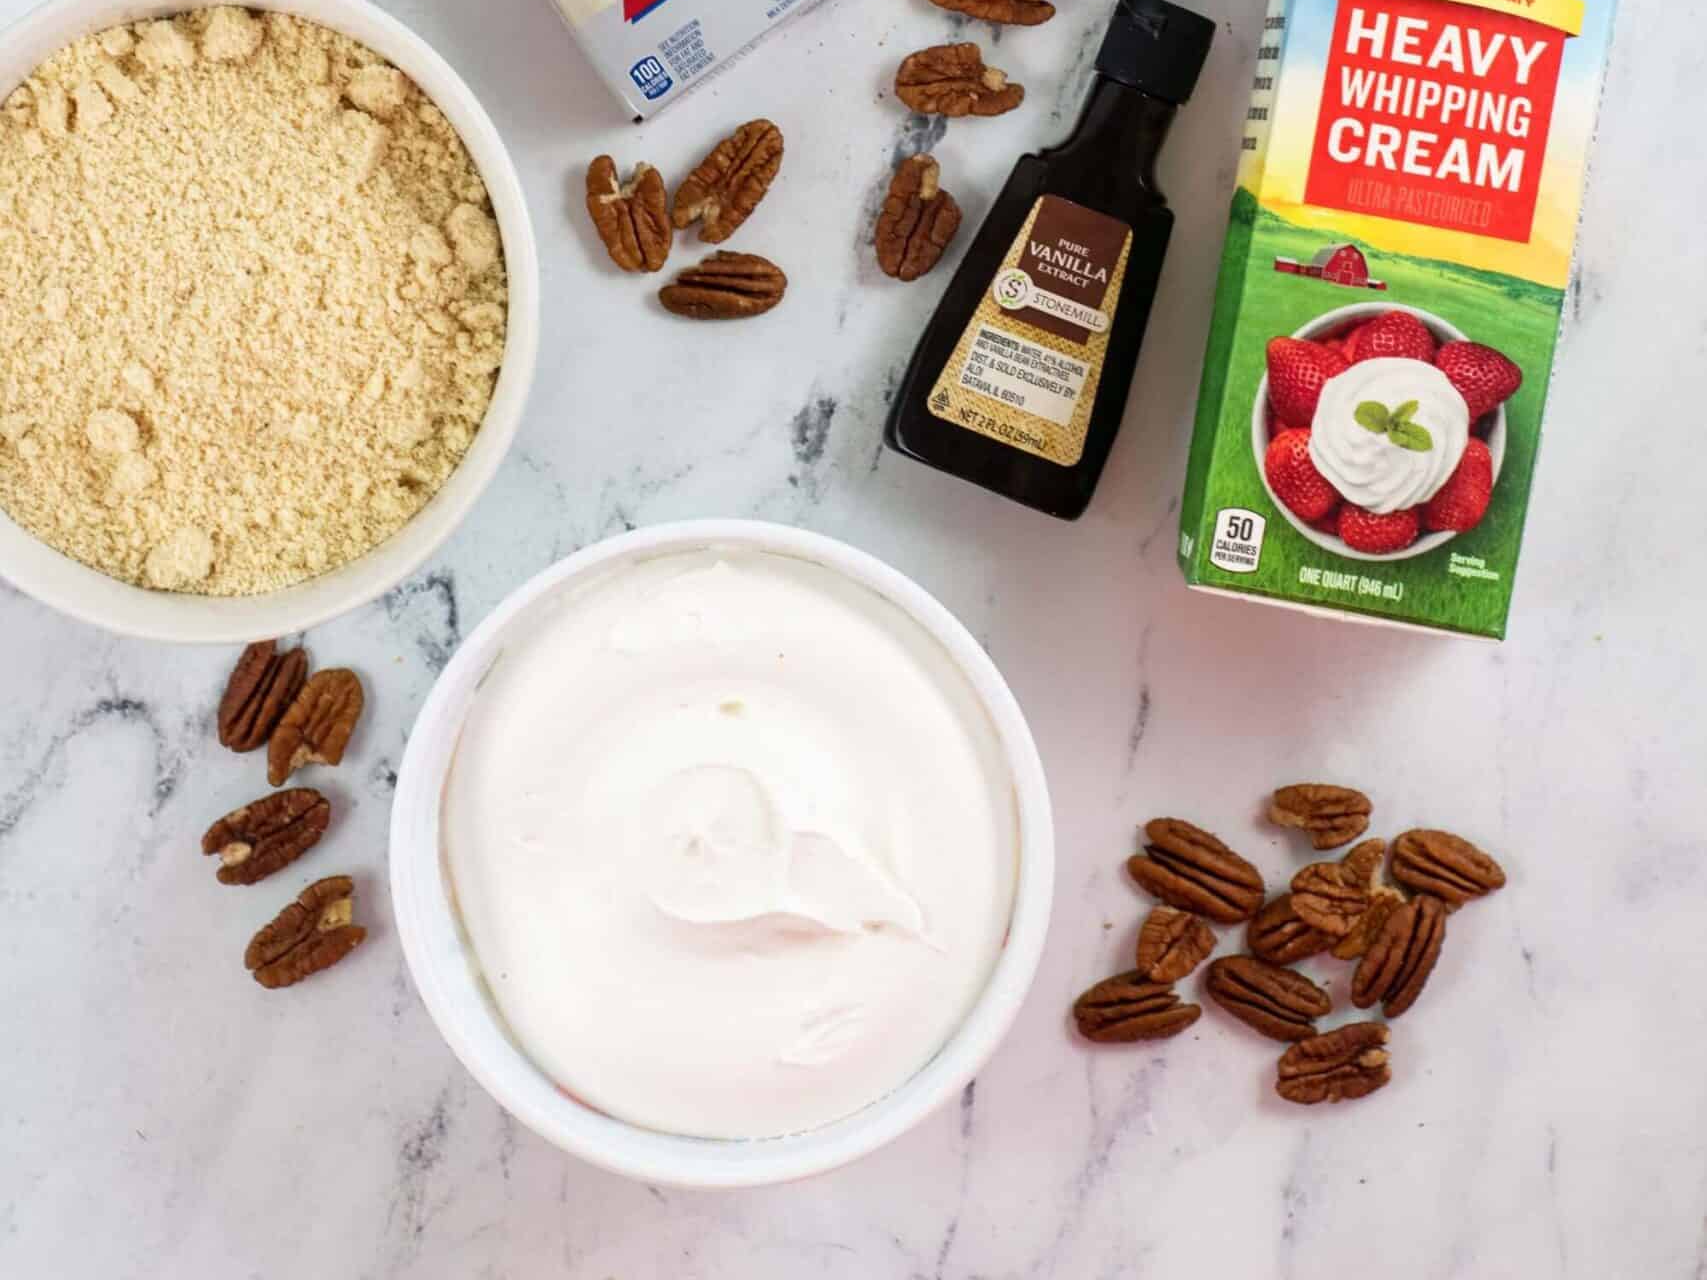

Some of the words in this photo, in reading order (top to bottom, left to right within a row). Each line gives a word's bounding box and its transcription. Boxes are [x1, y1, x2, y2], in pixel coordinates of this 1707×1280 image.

[1345, 7, 1547, 84] HEAVY
[631, 57, 661, 85] 100
[1341, 65, 1531, 137] WHIPPING
[1327, 117, 1524, 192] CREAM
[1345, 179, 1494, 227] ULTRA-PASTEURIZED
[1030, 240, 1106, 283] VANILLA
[1058, 238, 1089, 256] PURE
[1037, 262, 1089, 288] EXTRACT
[1032, 292, 1105, 328] STONEMILL
[965, 362, 983, 376] ALDI
[995, 361, 1017, 376] SOLD
[1015, 369, 1064, 394] EXCLUSIVELY
[957, 407, 977, 423] NET
[977, 415, 985, 426] 2
[985, 418, 998, 431] FL
[997, 422, 1014, 437] OZ
[1226, 515, 1253, 541] 50
[1215, 539, 1257, 555] CALORIES
[1297, 566, 1322, 585] ONE
[1321, 570, 1358, 591] QUART
